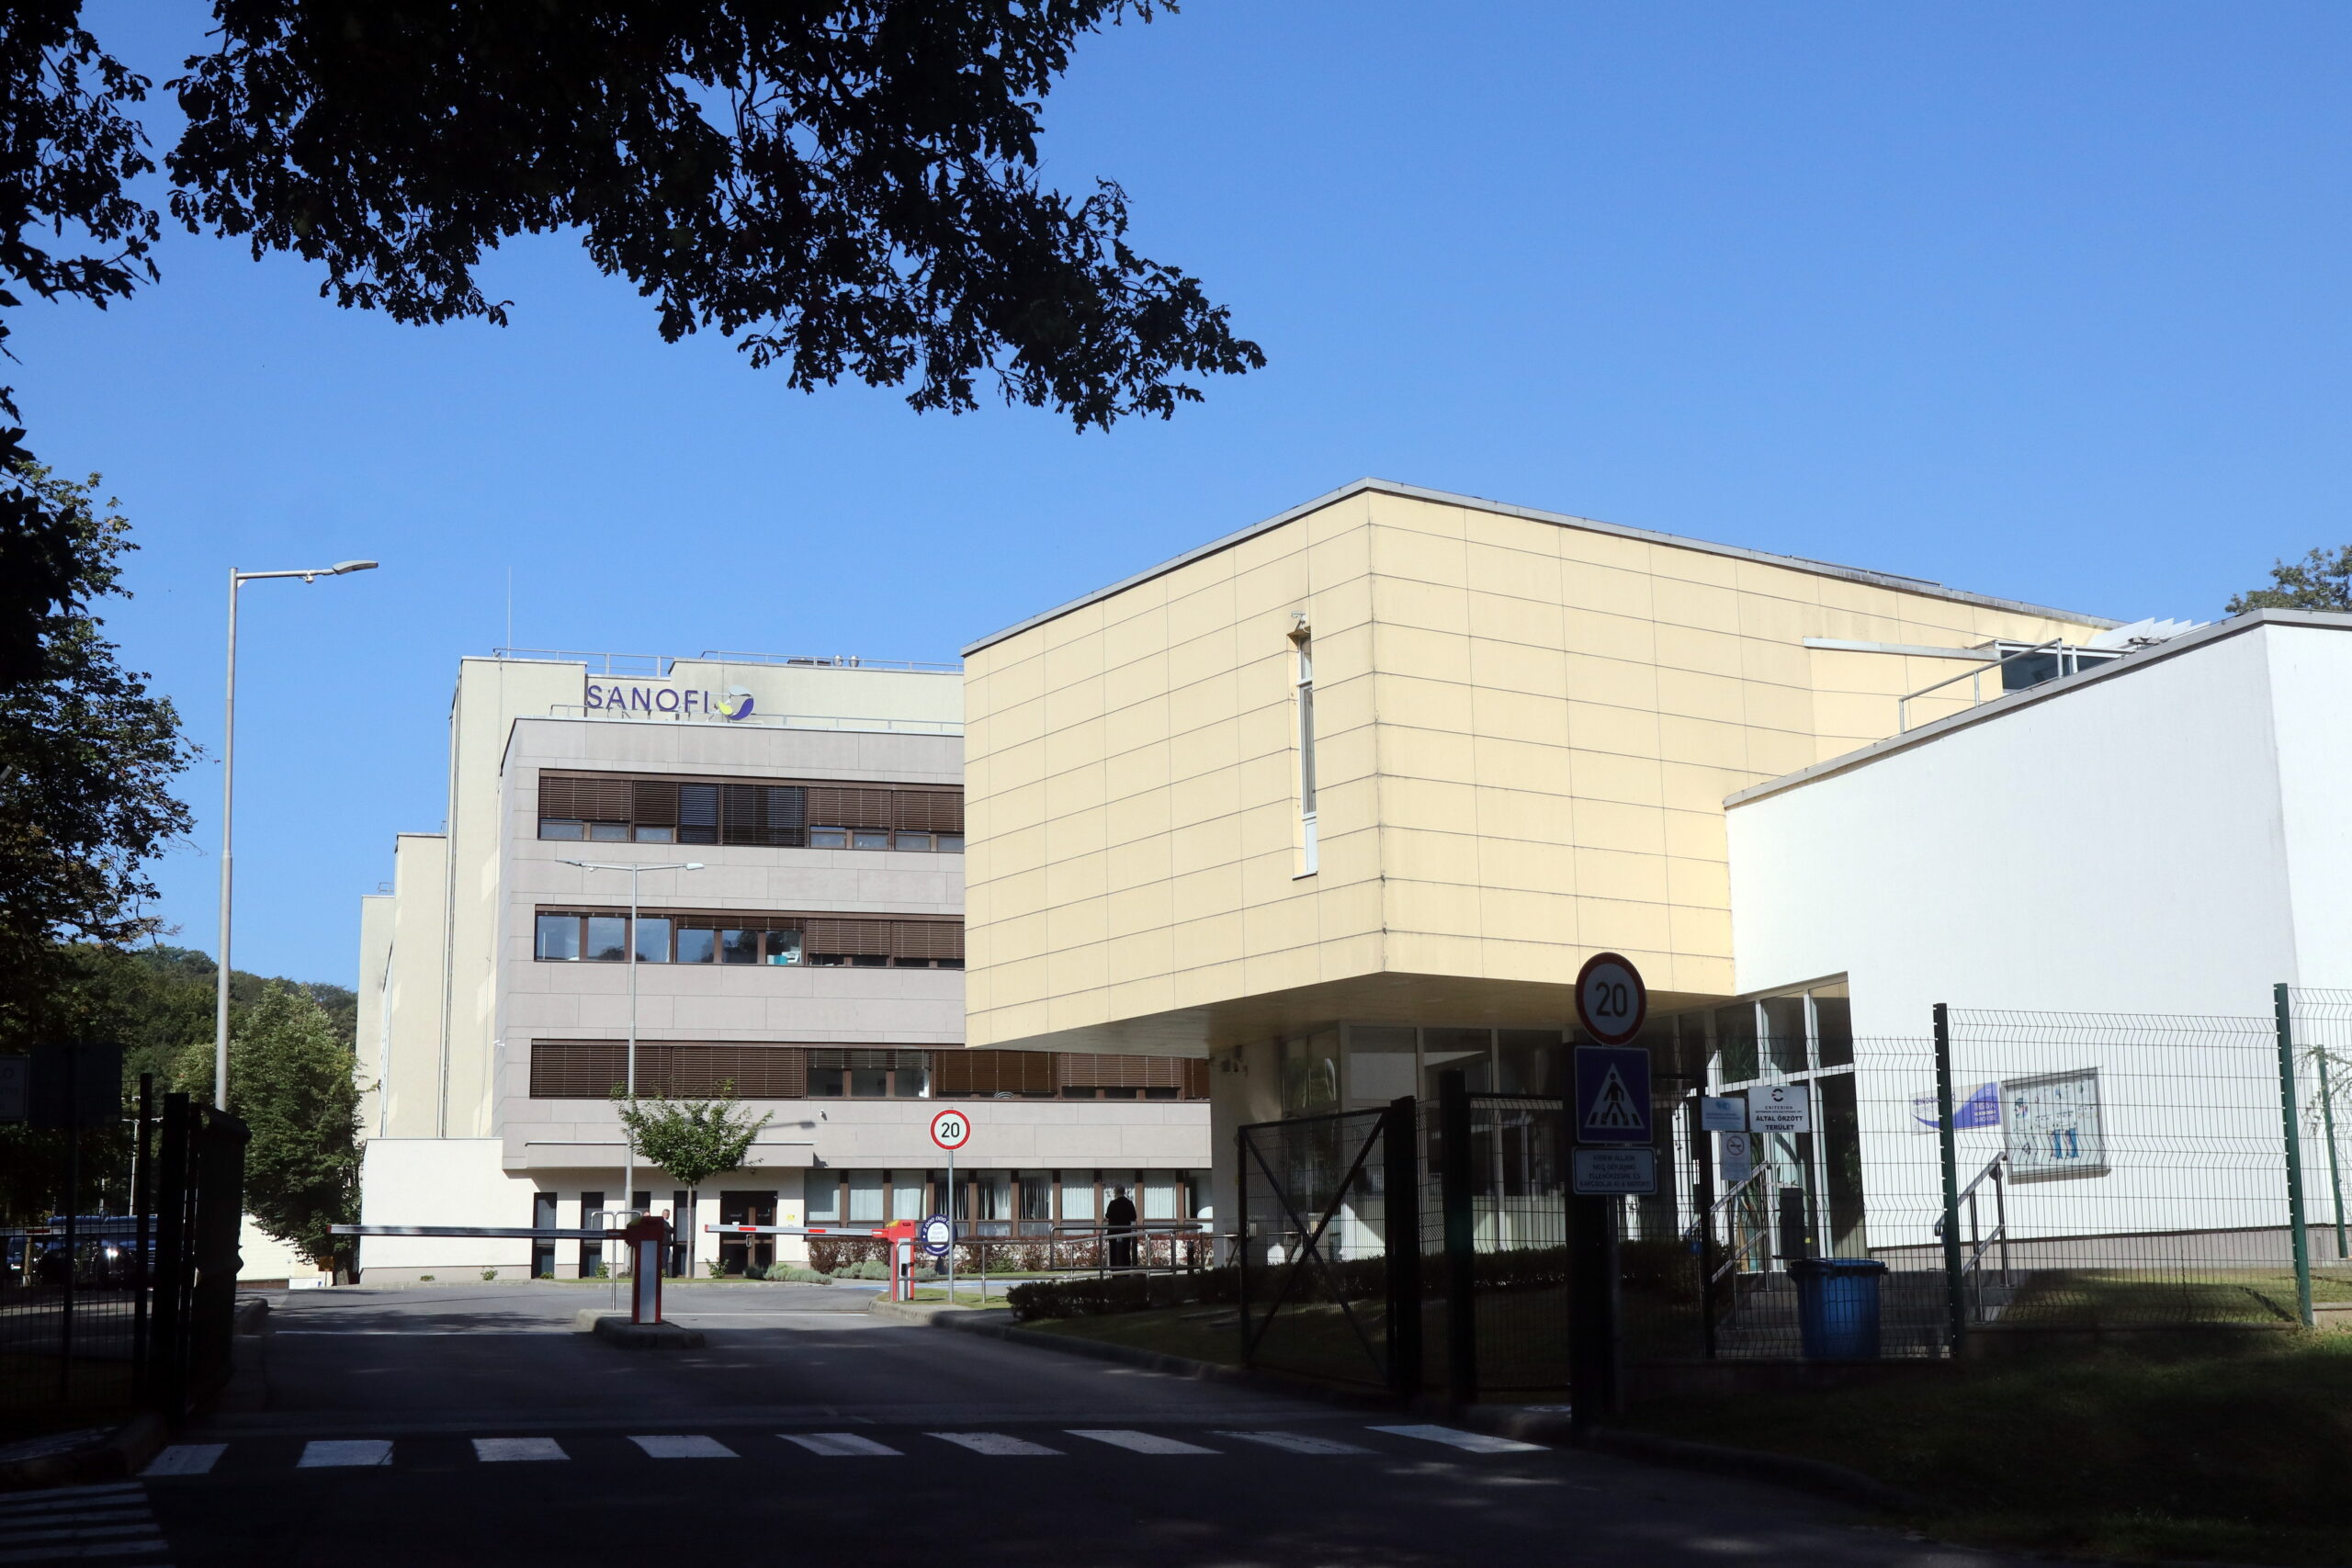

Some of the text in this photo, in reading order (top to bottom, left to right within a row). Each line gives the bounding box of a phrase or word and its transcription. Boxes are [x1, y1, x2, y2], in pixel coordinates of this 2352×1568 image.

[587, 685, 708, 713] SANOFI
[1596, 981, 1628, 1017] 20
[942, 1122, 959, 1137] 20
